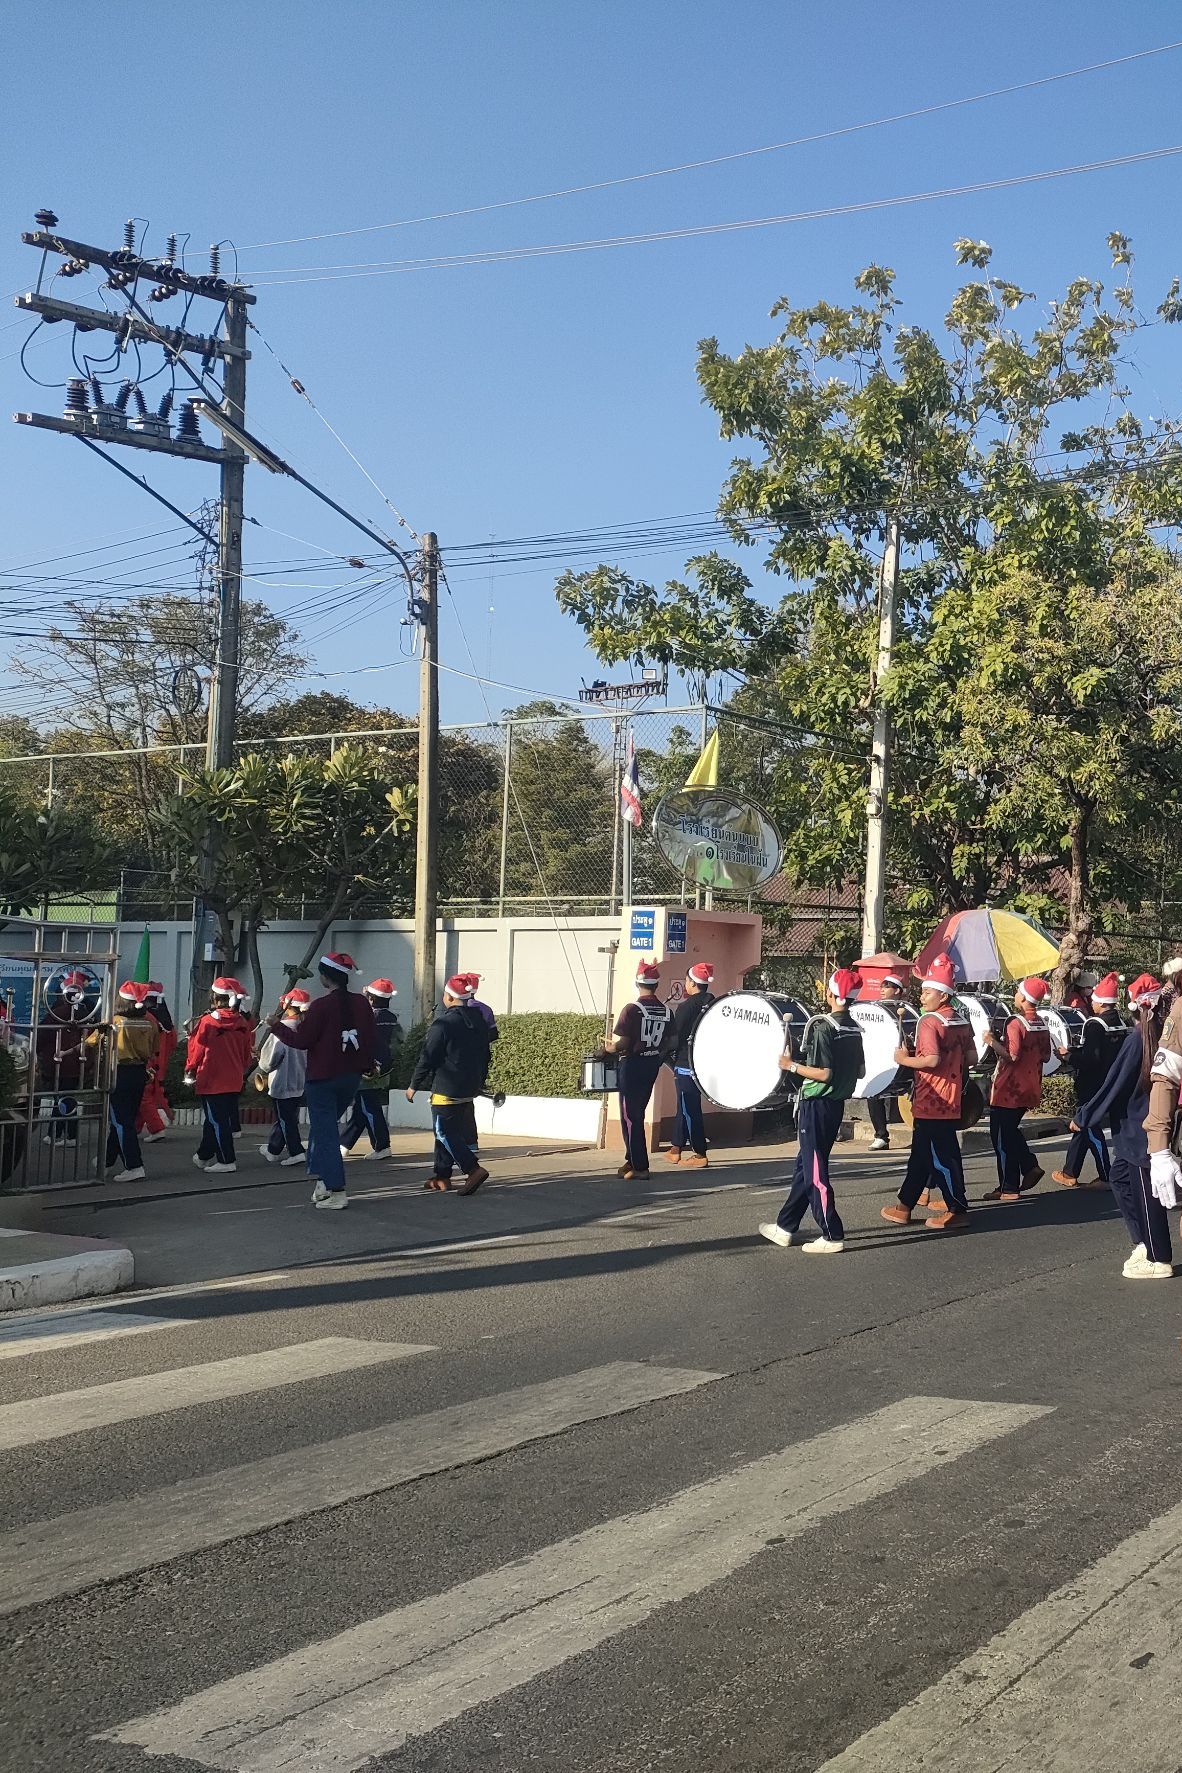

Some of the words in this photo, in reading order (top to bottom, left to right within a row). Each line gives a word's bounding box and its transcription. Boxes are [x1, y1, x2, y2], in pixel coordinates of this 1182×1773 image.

[632, 914, 648, 928] ประตู
[631, 937, 648, 947] GATE
[668, 939, 681, 948] GATE
[733, 1006, 770, 1026] YAMAHA
[856, 1011, 885, 1023] YAMAHA
[1049, 1019, 1060, 1028] AHA
[640, 1016, 666, 1048] 48
